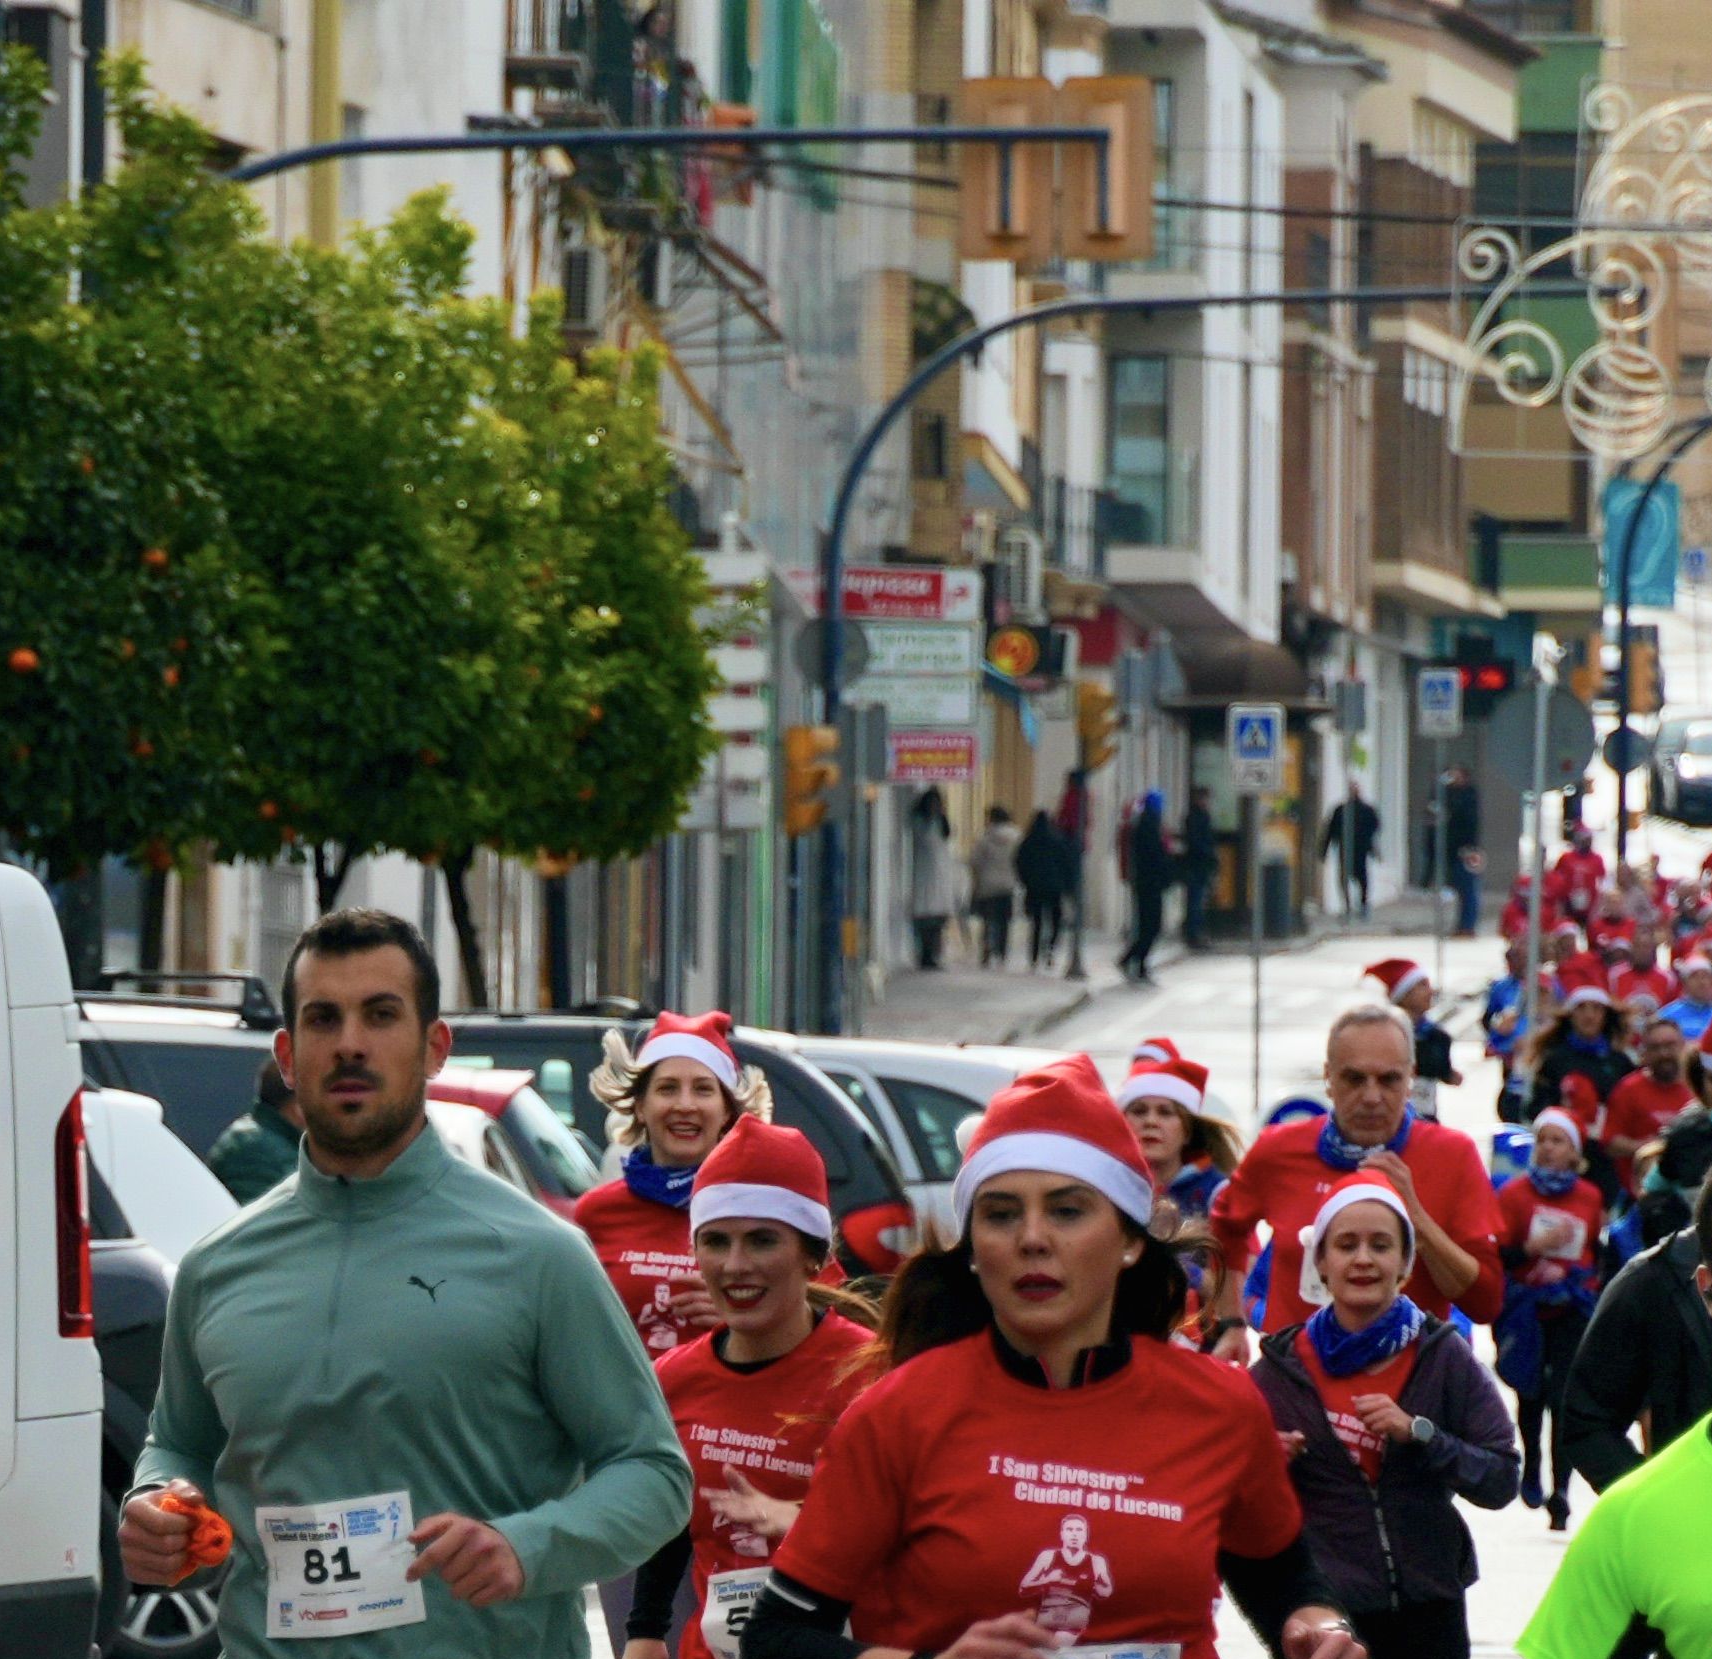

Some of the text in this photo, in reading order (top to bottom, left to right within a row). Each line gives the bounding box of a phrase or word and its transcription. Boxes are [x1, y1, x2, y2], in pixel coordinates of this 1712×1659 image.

[697, 1425, 718, 1442] San
[719, 1427, 777, 1451] Silvestre
[701, 1443, 815, 1478] Ciudad de Lucena
[1002, 1456, 1039, 1481] San
[1041, 1463, 1128, 1492] Silvestre
[1014, 1481, 1184, 1522] Ciudad de Lucena
[304, 1546, 362, 1585] 81
